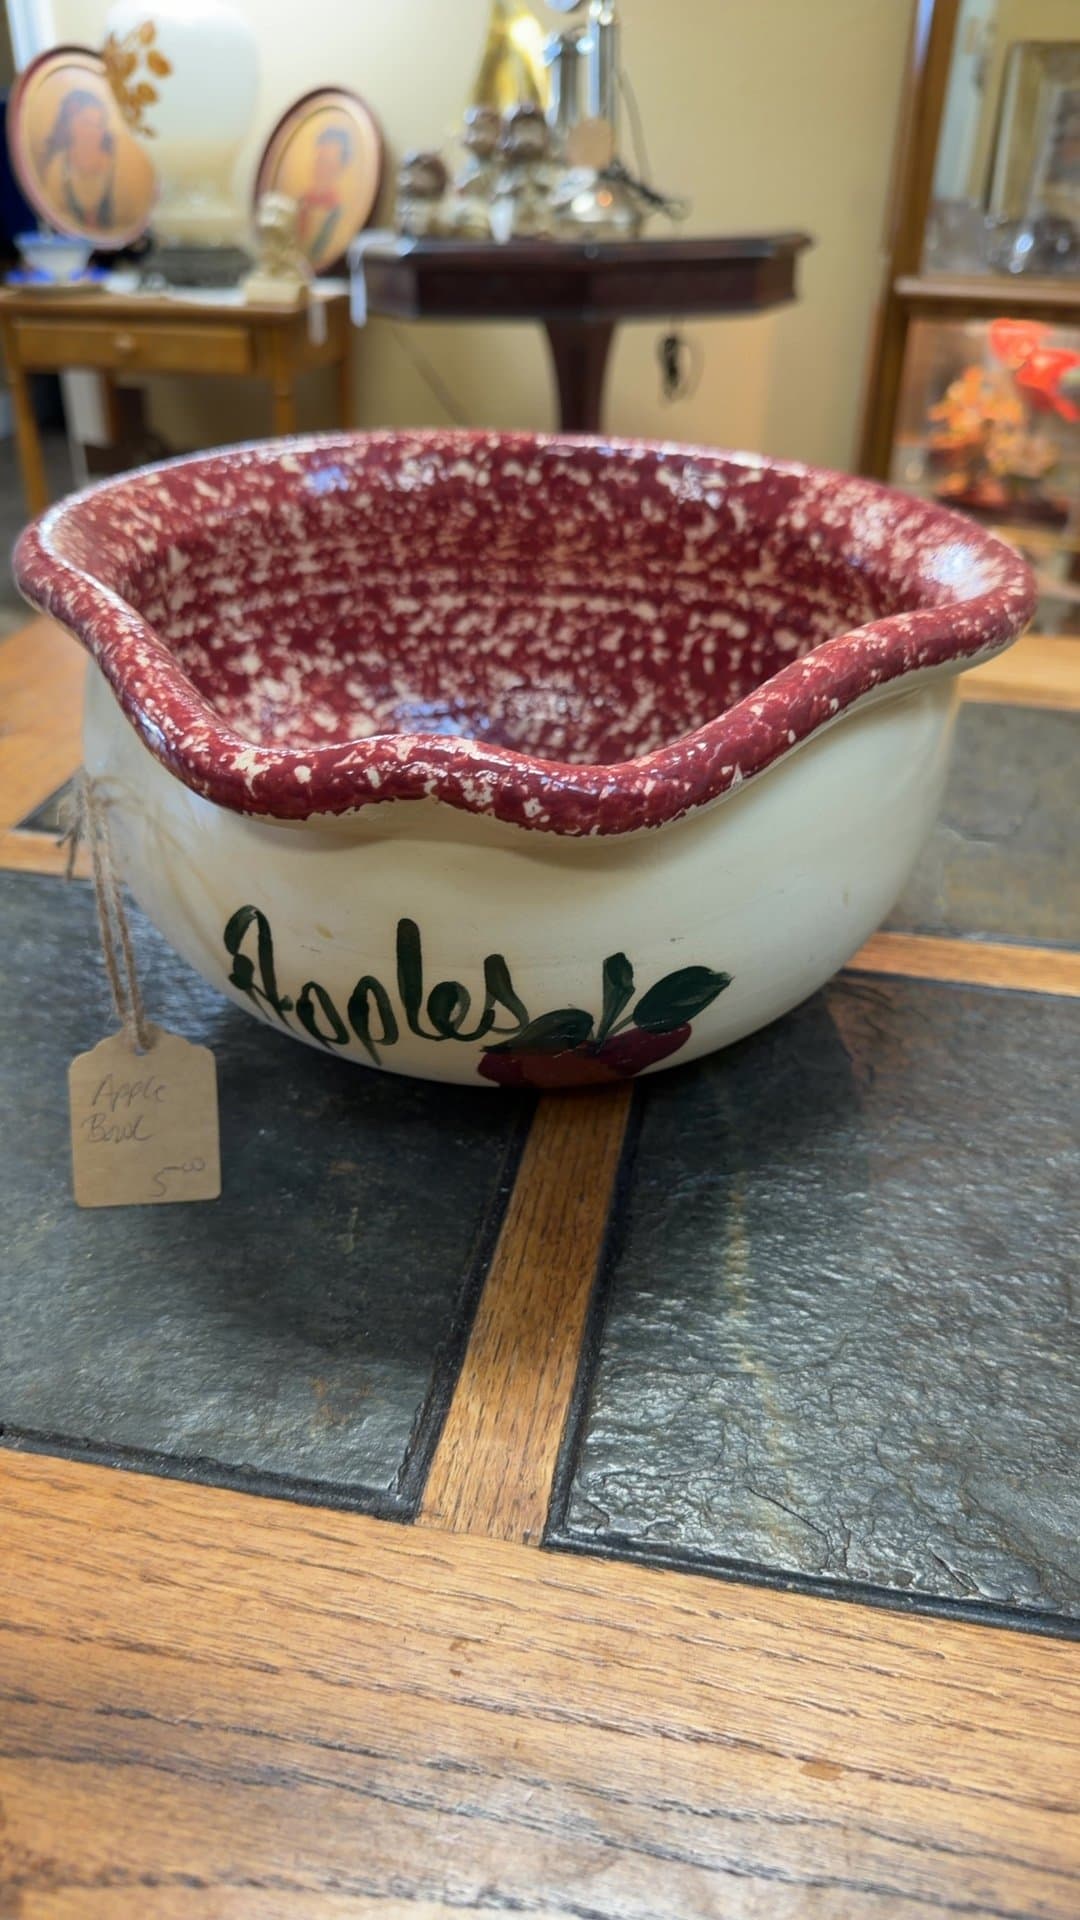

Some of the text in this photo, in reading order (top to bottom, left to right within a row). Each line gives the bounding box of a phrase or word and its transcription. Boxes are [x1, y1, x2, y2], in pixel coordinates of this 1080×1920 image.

[223, 904, 530, 1066] Apples
[91, 1073, 166, 1112] Apple
[81, 1112, 153, 1144] Bowl
